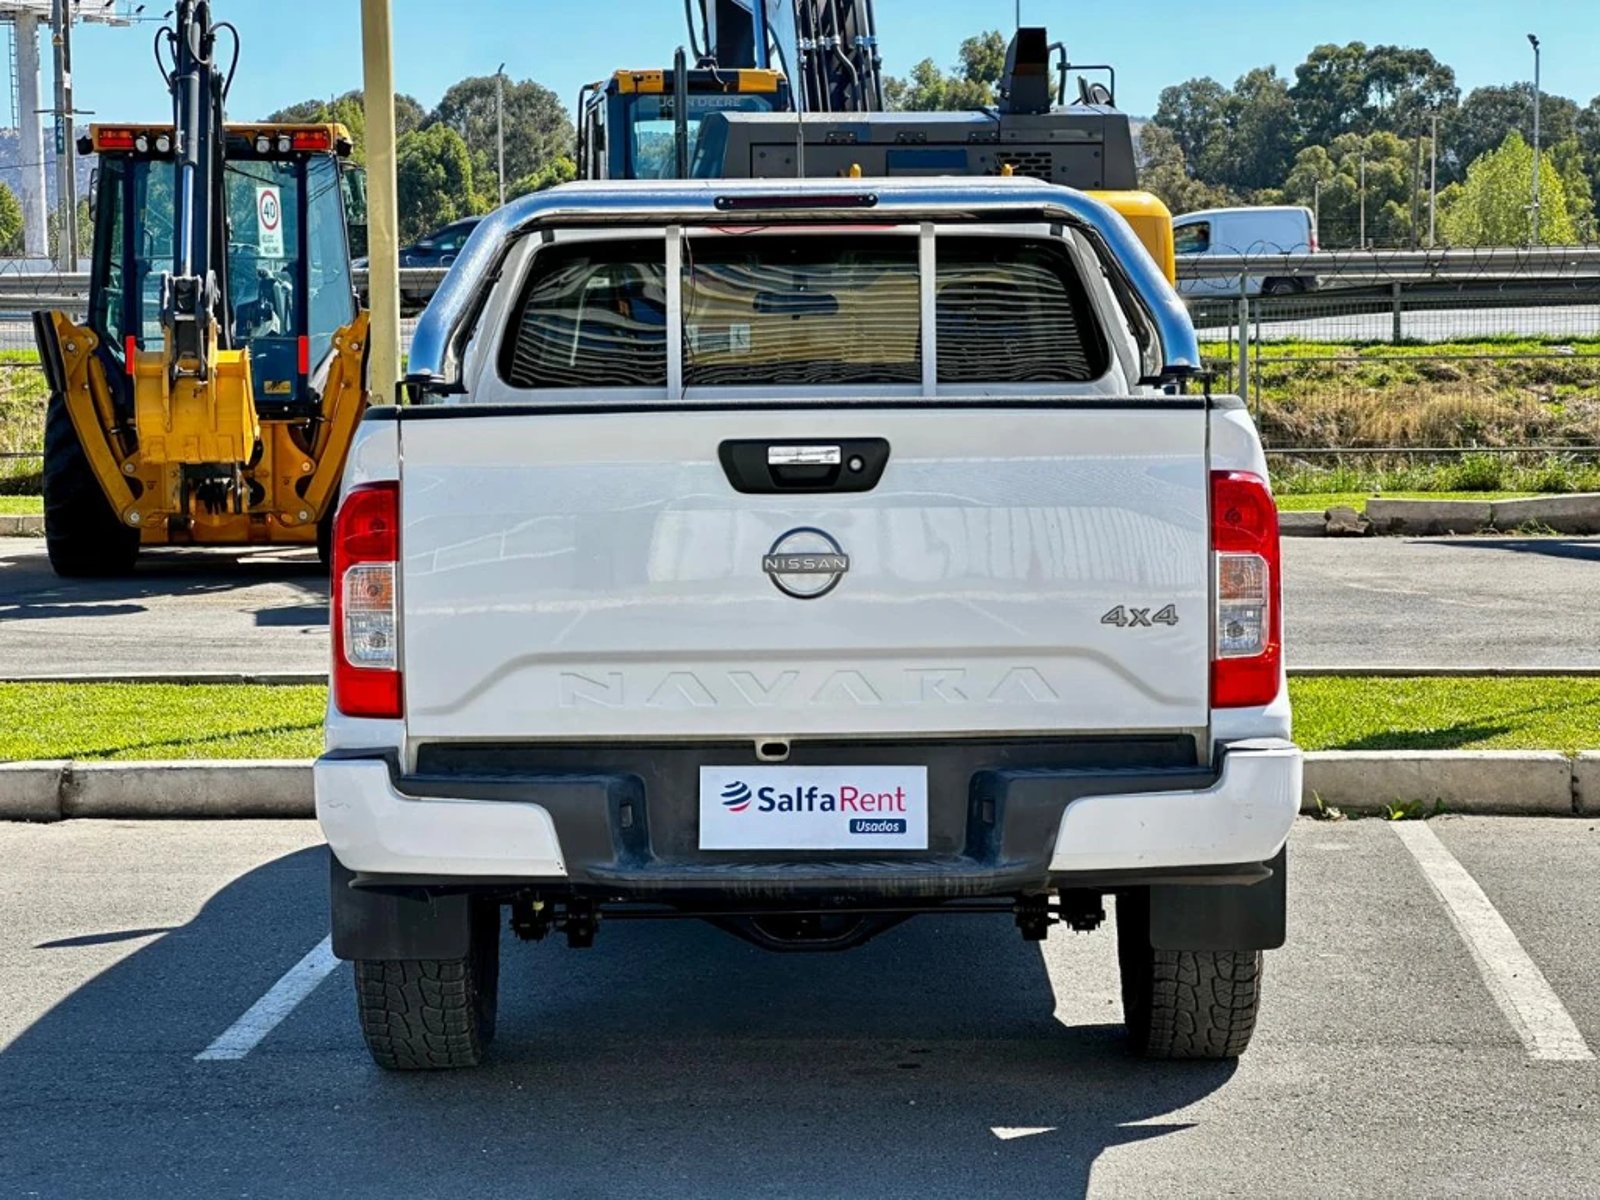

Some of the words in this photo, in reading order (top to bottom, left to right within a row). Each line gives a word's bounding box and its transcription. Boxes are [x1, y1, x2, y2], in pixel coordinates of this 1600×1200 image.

[660, 96, 695, 107] JON
[698, 97, 741, 107] DEERE
[263, 201, 276, 219] 40
[765, 558, 847, 570] NISSAN
[1100, 603, 1179, 627] 4x4
[559, 667, 1061, 708] NAVARA
[757, 786, 907, 812] SalfaRent
[855, 821, 900, 832] Usados
